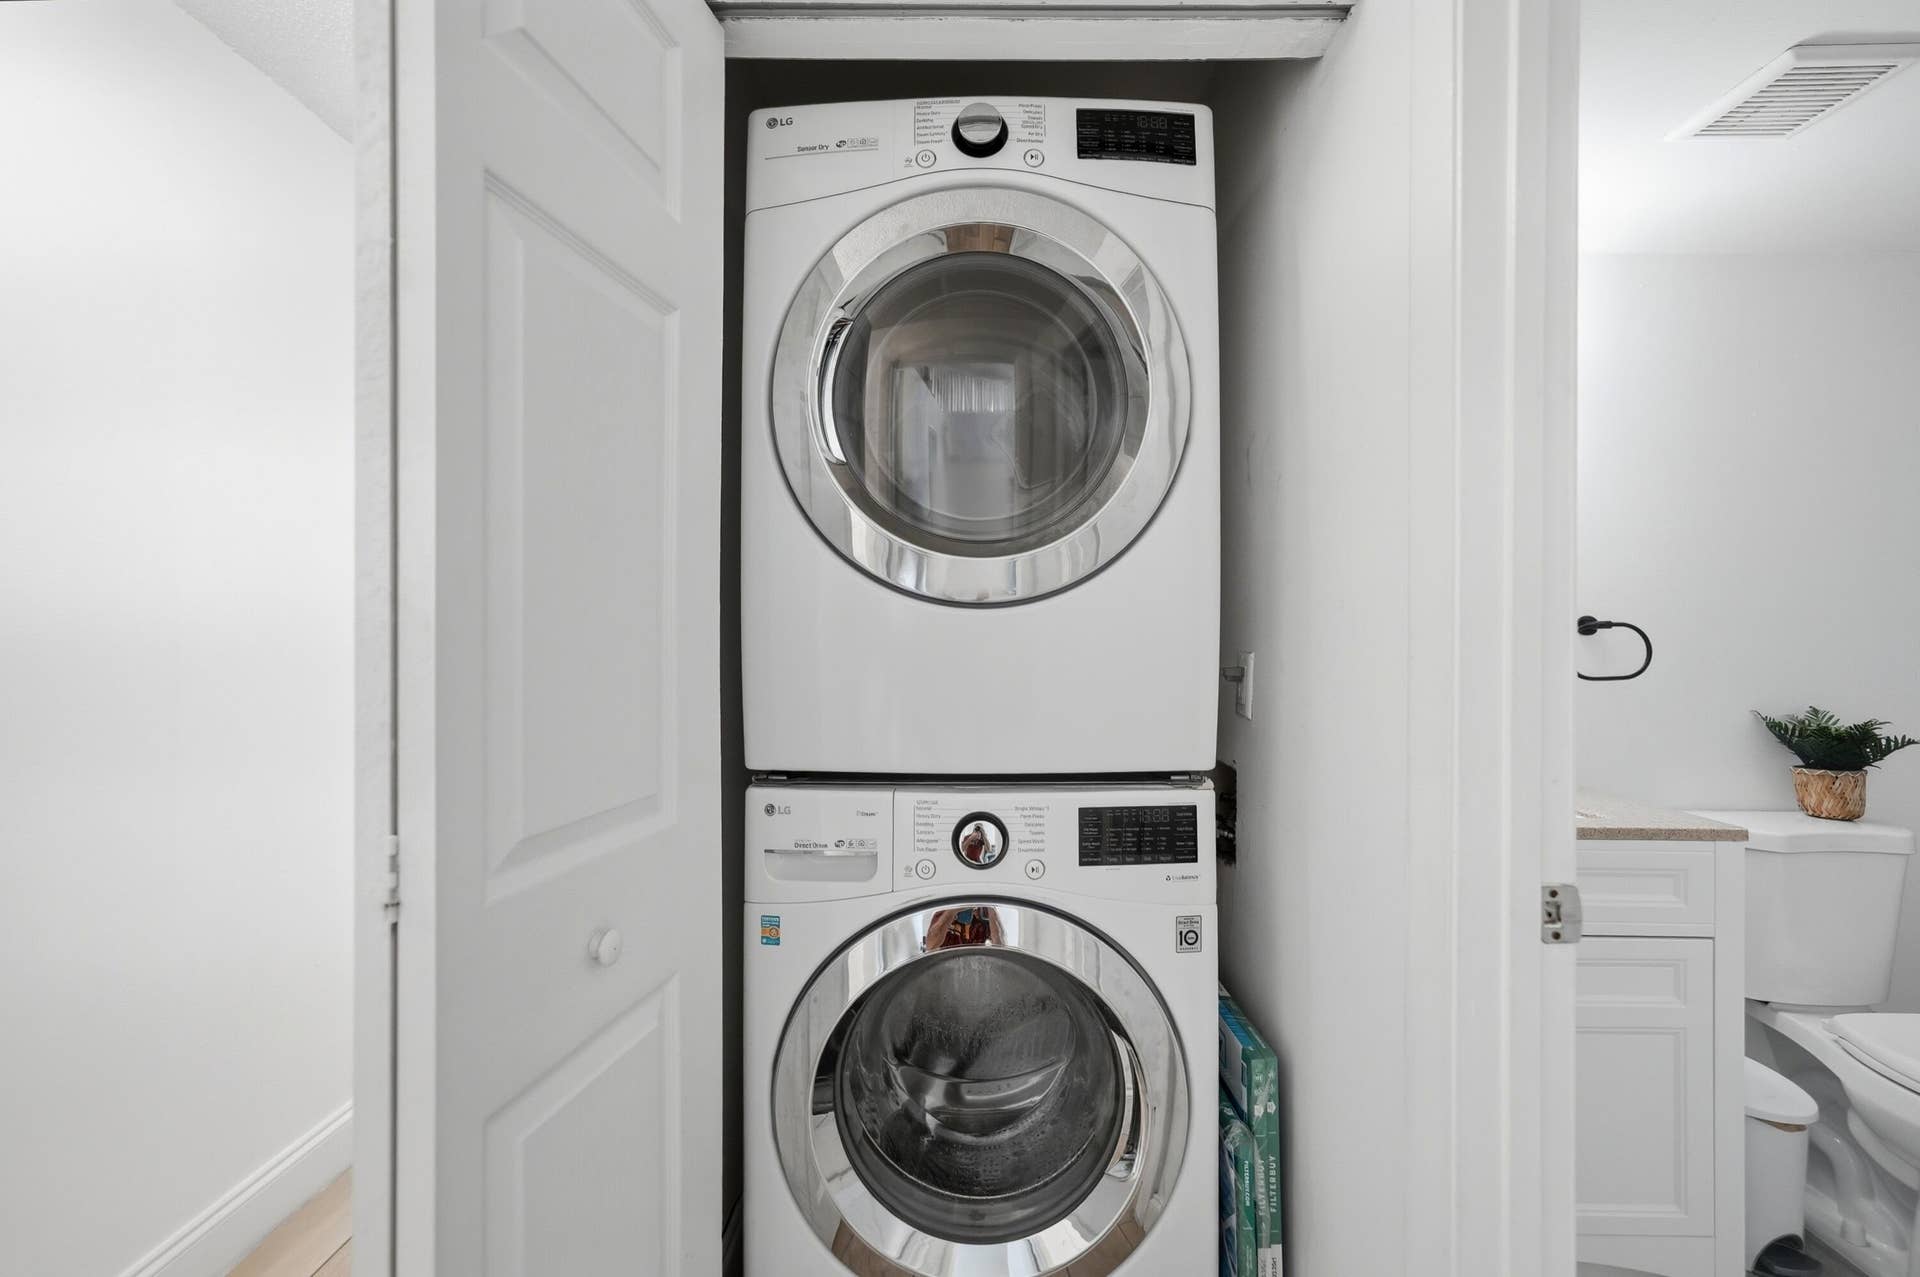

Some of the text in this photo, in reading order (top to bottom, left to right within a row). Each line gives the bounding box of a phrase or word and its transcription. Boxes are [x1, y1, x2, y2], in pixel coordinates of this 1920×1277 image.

[779, 117, 794, 127] LG
[797, 143, 830, 153] Sensor Dry
[777, 805, 792, 815] LG
[794, 841, 812, 849] Direct
[1267, 1153, 1277, 1214] FILTERBUY
